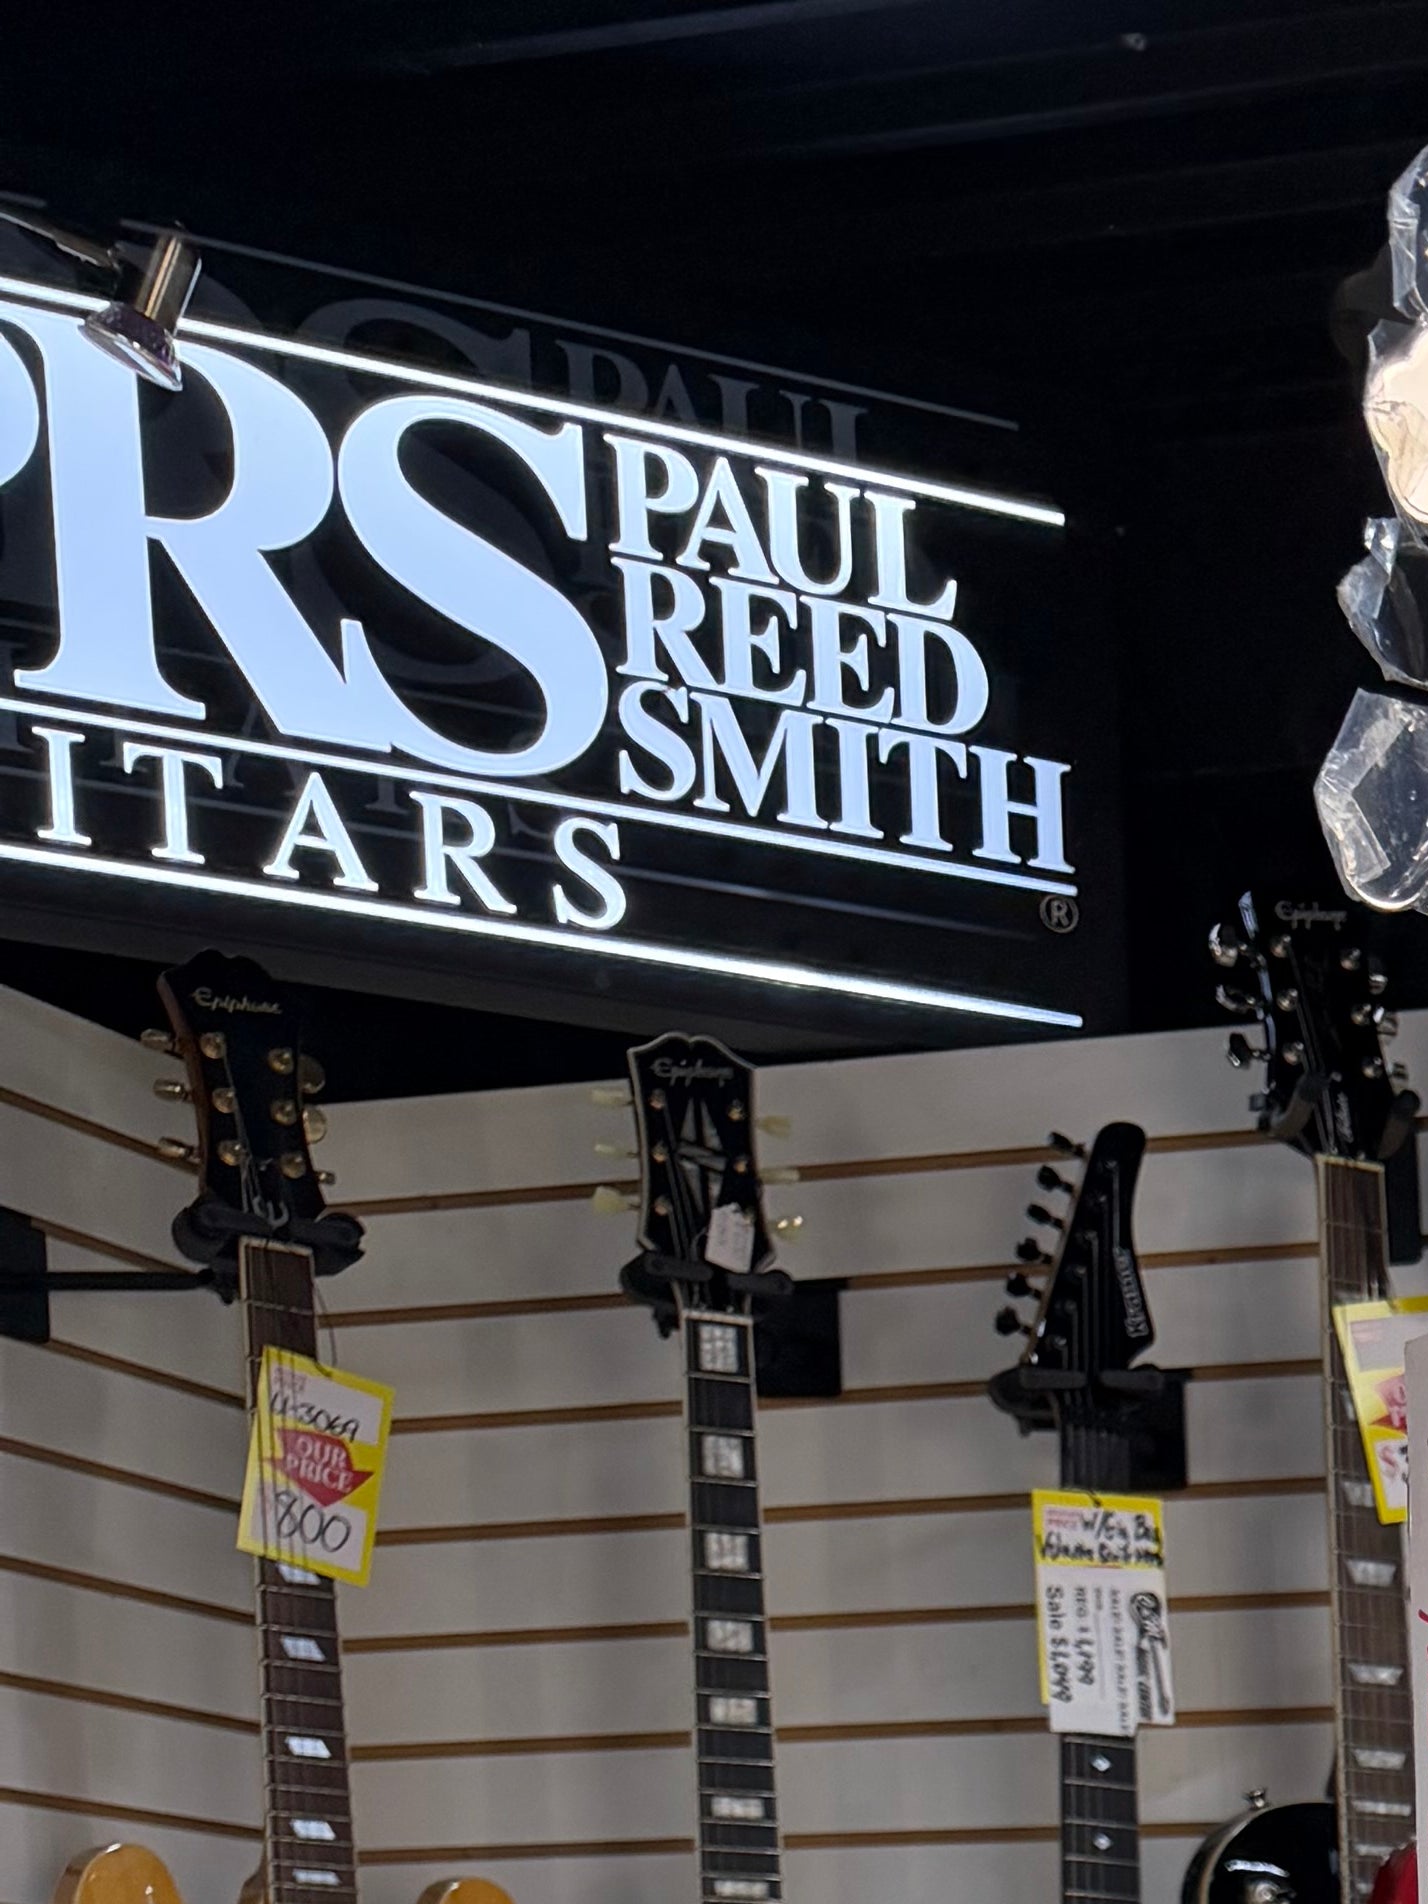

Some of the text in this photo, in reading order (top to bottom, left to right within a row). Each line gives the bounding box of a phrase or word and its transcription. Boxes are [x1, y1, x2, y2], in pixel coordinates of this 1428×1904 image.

[0, 303, 608, 777] RS
[605, 434, 956, 618] PAUL
[613, 556, 989, 735] REED
[620, 684, 1075, 873] SMITH
[286, 1455, 354, 1493] PRICE
[296, 1437, 347, 1469] OUR
[1046, 1584, 1064, 1631] Sale
